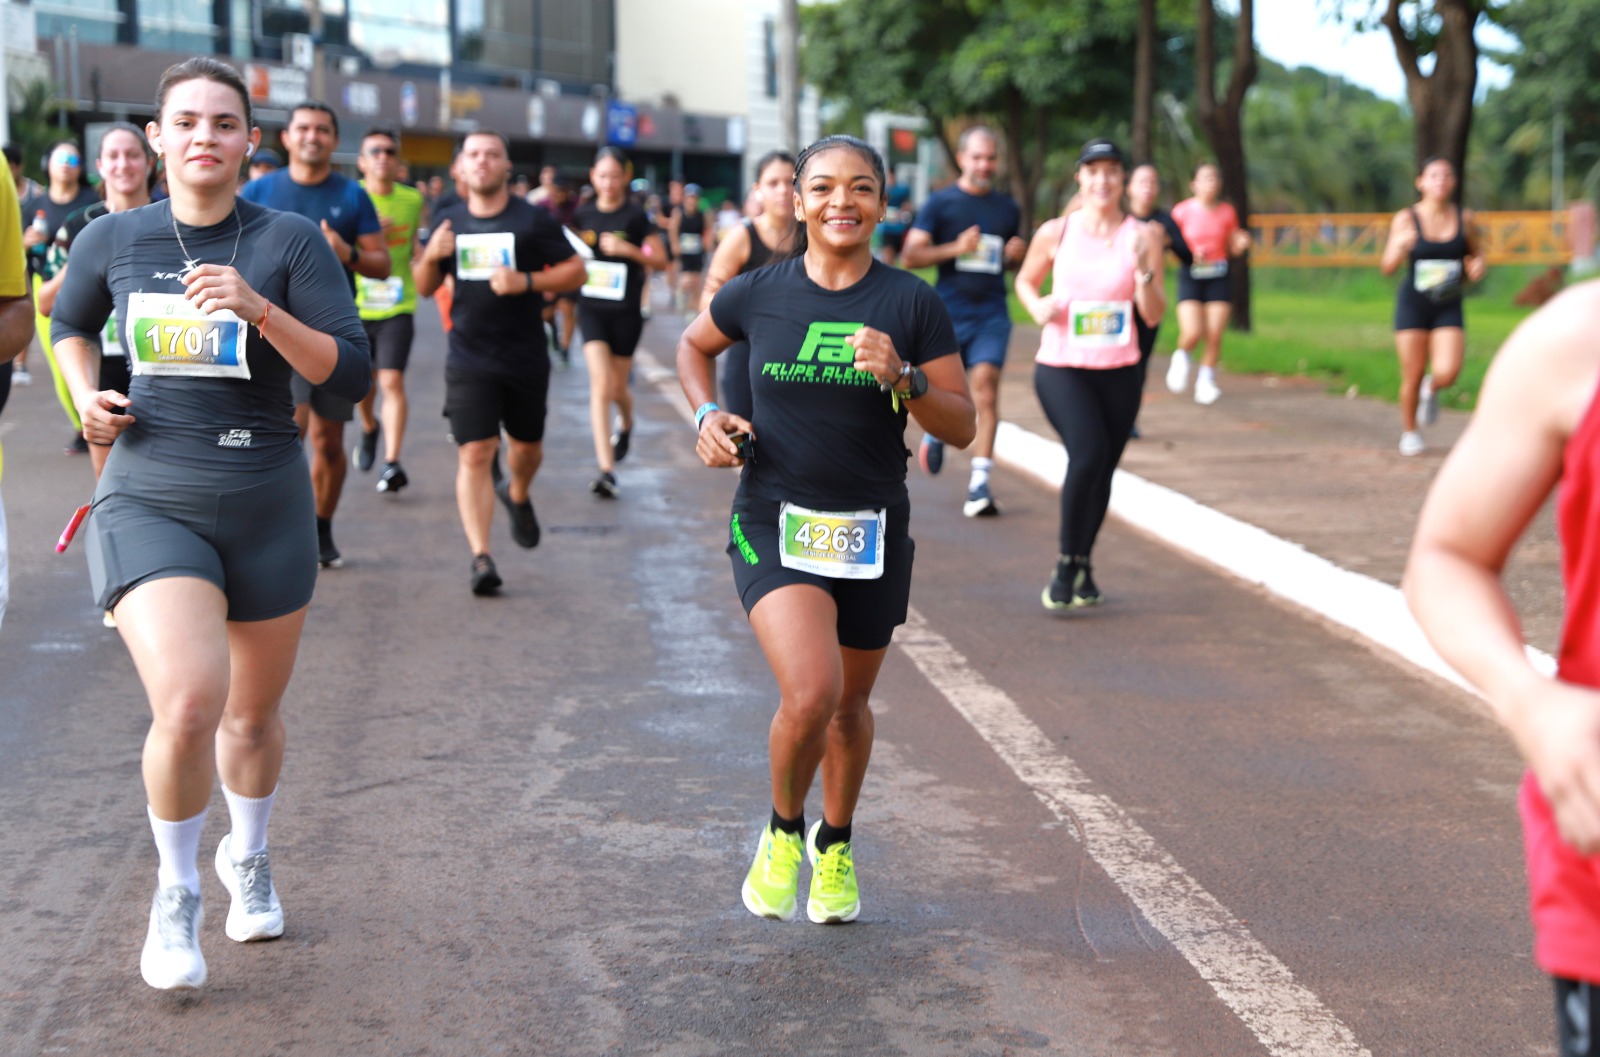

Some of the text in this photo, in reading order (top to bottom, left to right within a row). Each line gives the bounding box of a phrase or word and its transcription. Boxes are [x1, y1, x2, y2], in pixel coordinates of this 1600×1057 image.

[145, 324, 220, 357] 1701
[761, 362, 817, 377] FELIPE
[217, 436, 252, 447] SlimFit
[794, 521, 866, 554] 4263
